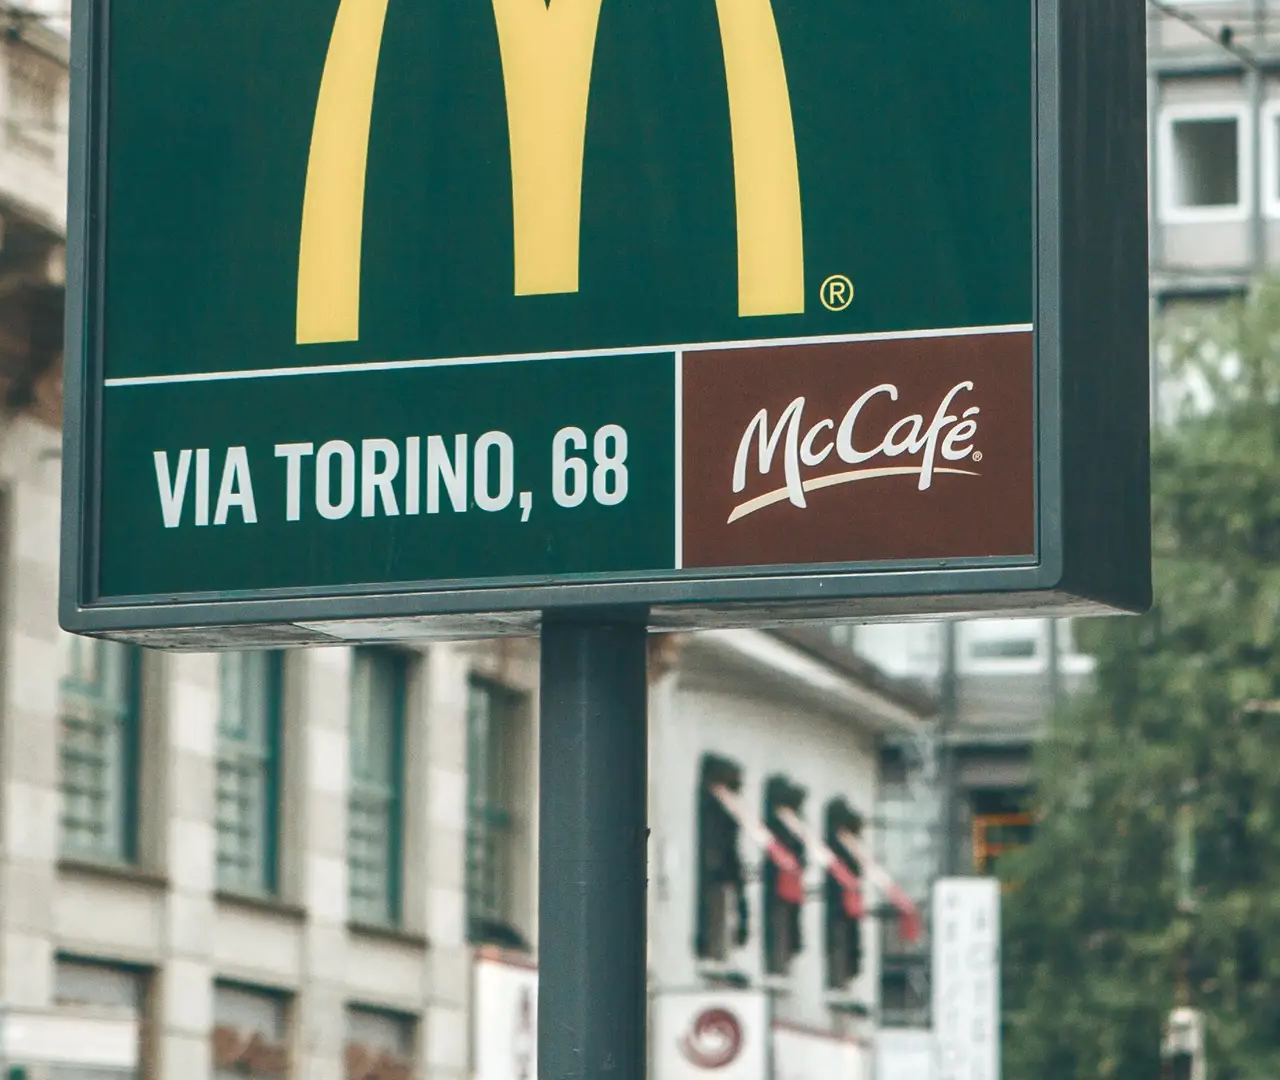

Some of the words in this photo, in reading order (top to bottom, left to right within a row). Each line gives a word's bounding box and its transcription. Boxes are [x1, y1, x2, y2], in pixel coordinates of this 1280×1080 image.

[153, 446, 258, 528] VIA
[274, 430, 533, 522] TORINO,
[551, 423, 629, 508] 68
[732, 380, 981, 508] McCafé
